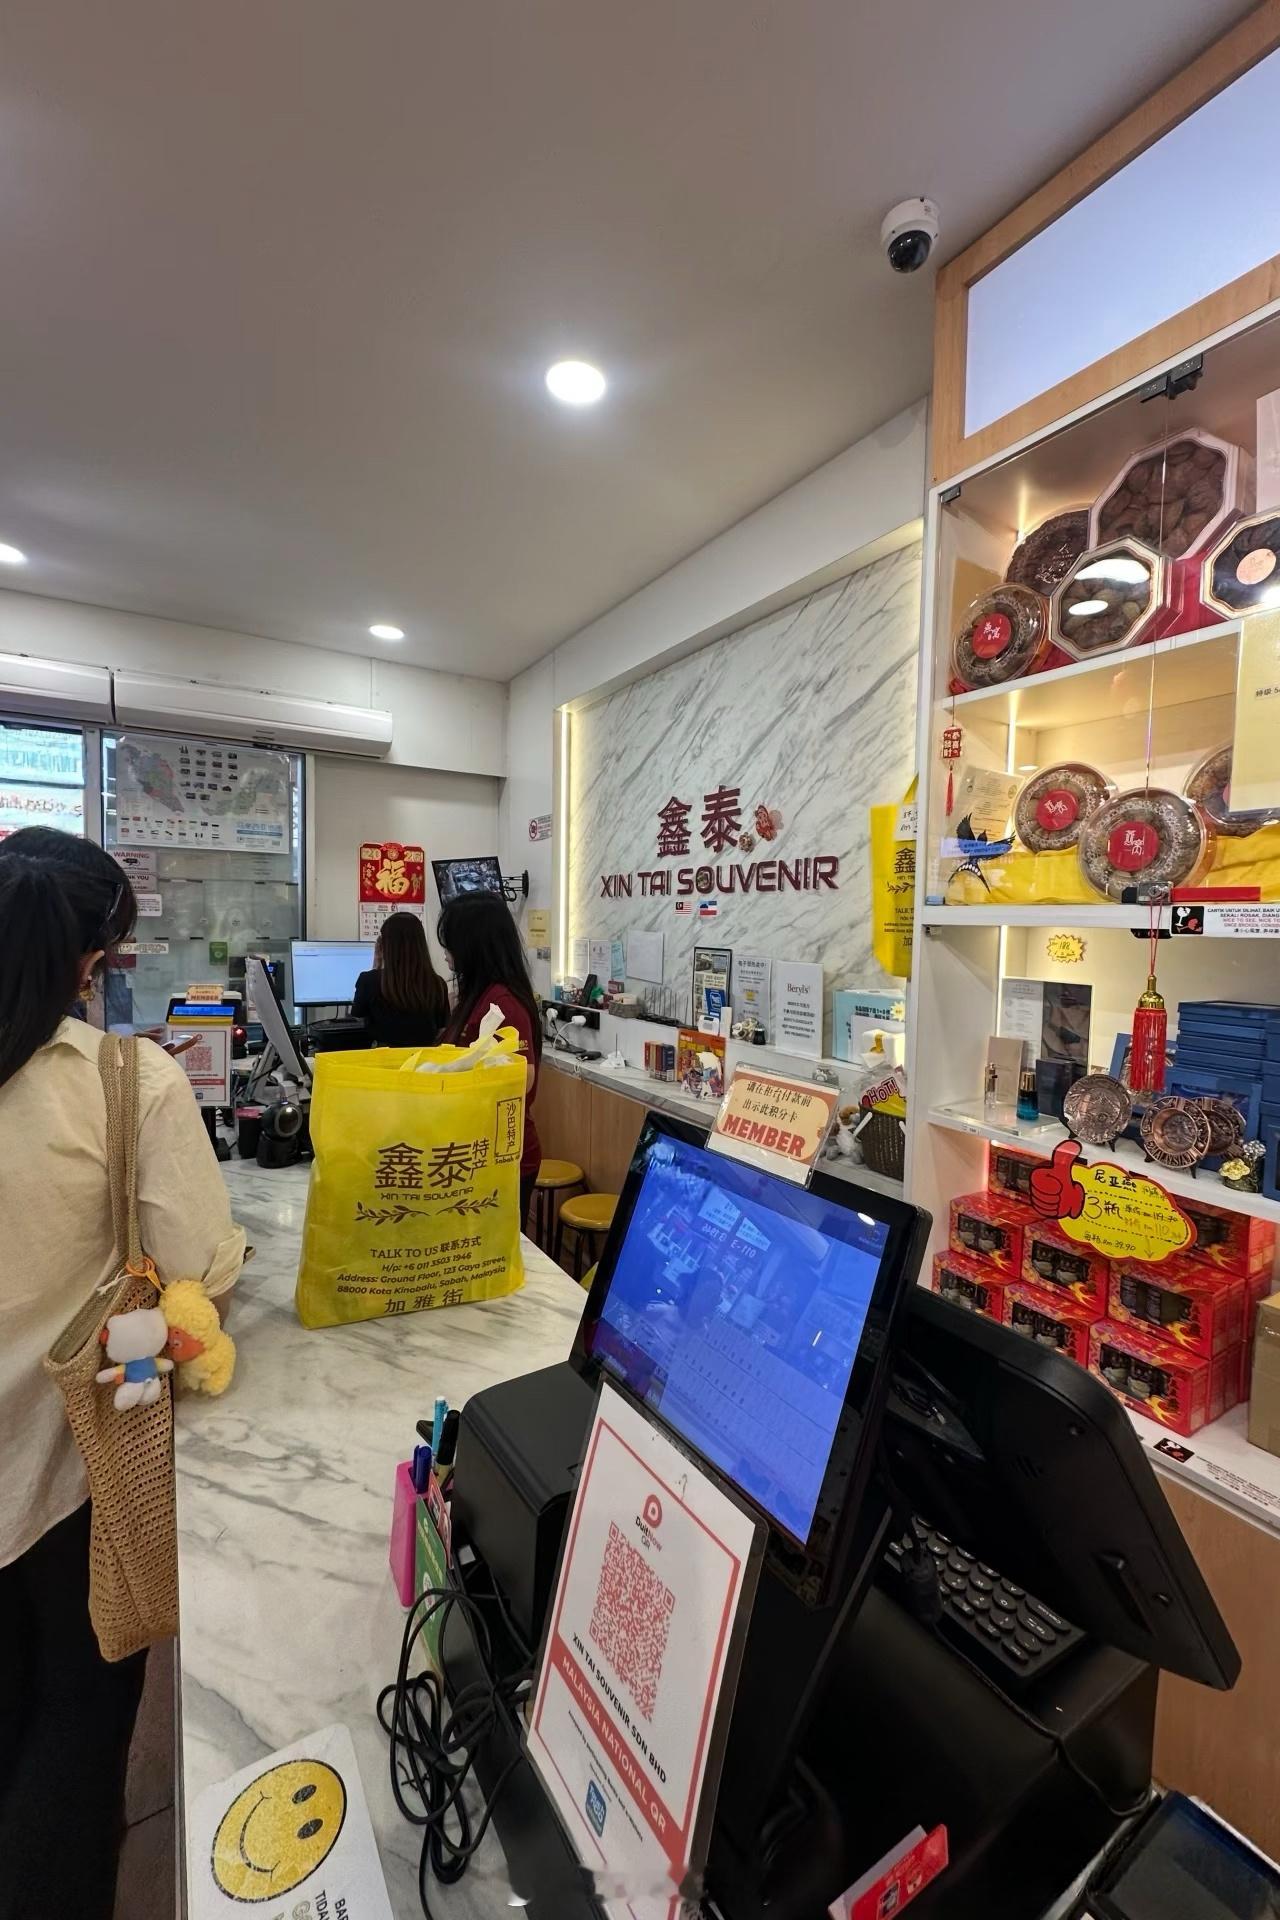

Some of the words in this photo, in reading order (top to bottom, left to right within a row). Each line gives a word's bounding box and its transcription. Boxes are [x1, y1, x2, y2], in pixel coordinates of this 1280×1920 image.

[657, 785, 742, 857] 鑫泰
[114, 851, 150, 859] WARNING
[375, 859, 411, 898] 福
[600, 873, 633, 898] XIN
[637, 869, 672, 896] TAI
[677, 855, 839, 895] SOUVENIR
[746, 1080, 813, 1108] 请在柜台付款前
[867, 1077, 899, 1105] HOT!
[742, 1099, 800, 1123] 出示此积分卡
[506, 1102, 517, 1153] 沙巴特产
[722, 1113, 806, 1158] MEMBER
[374, 1141, 473, 1190] 鑫泰
[470, 1137, 490, 1181] 特产
[371, 1248, 402, 1259] TALK
[405, 1248, 421, 1258] TO
[424, 1247, 438, 1256] US
[440, 1236, 482, 1252] 联系方式
[452, 1252, 473, 1262] 1946
[337, 1274, 379, 1283] Address:
[380, 1275, 415, 1284] Ground
[417, 1271, 442, 1282] Floor,
[443, 1267, 457, 1276] 123
[458, 1263, 481, 1274] Gaya
[369, 1287, 393, 1296] Kota
[394, 1284, 437, 1295] Kinabalu,
[440, 1276, 468, 1288] Sabah,
[470, 1265, 506, 1281] Malaysia
[384, 1289, 464, 1312] 加雅街
[635, 1515, 662, 1552] DuitNow
[641, 1535, 650, 1550] QR
[572, 1632, 584, 1655] XIN
[585, 1652, 595, 1672] TAI
[596, 1669, 630, 1729] SOUVENIR
[631, 1726, 648, 1755] SDN
[648, 1752, 666, 1784] BHD
[562, 1655, 601, 1726] MALAYSIA
[602, 1720, 648, 1806] NATIONAL
[650, 1802, 667, 1834] QR
[315, 1889, 330, 1920] TIDA
